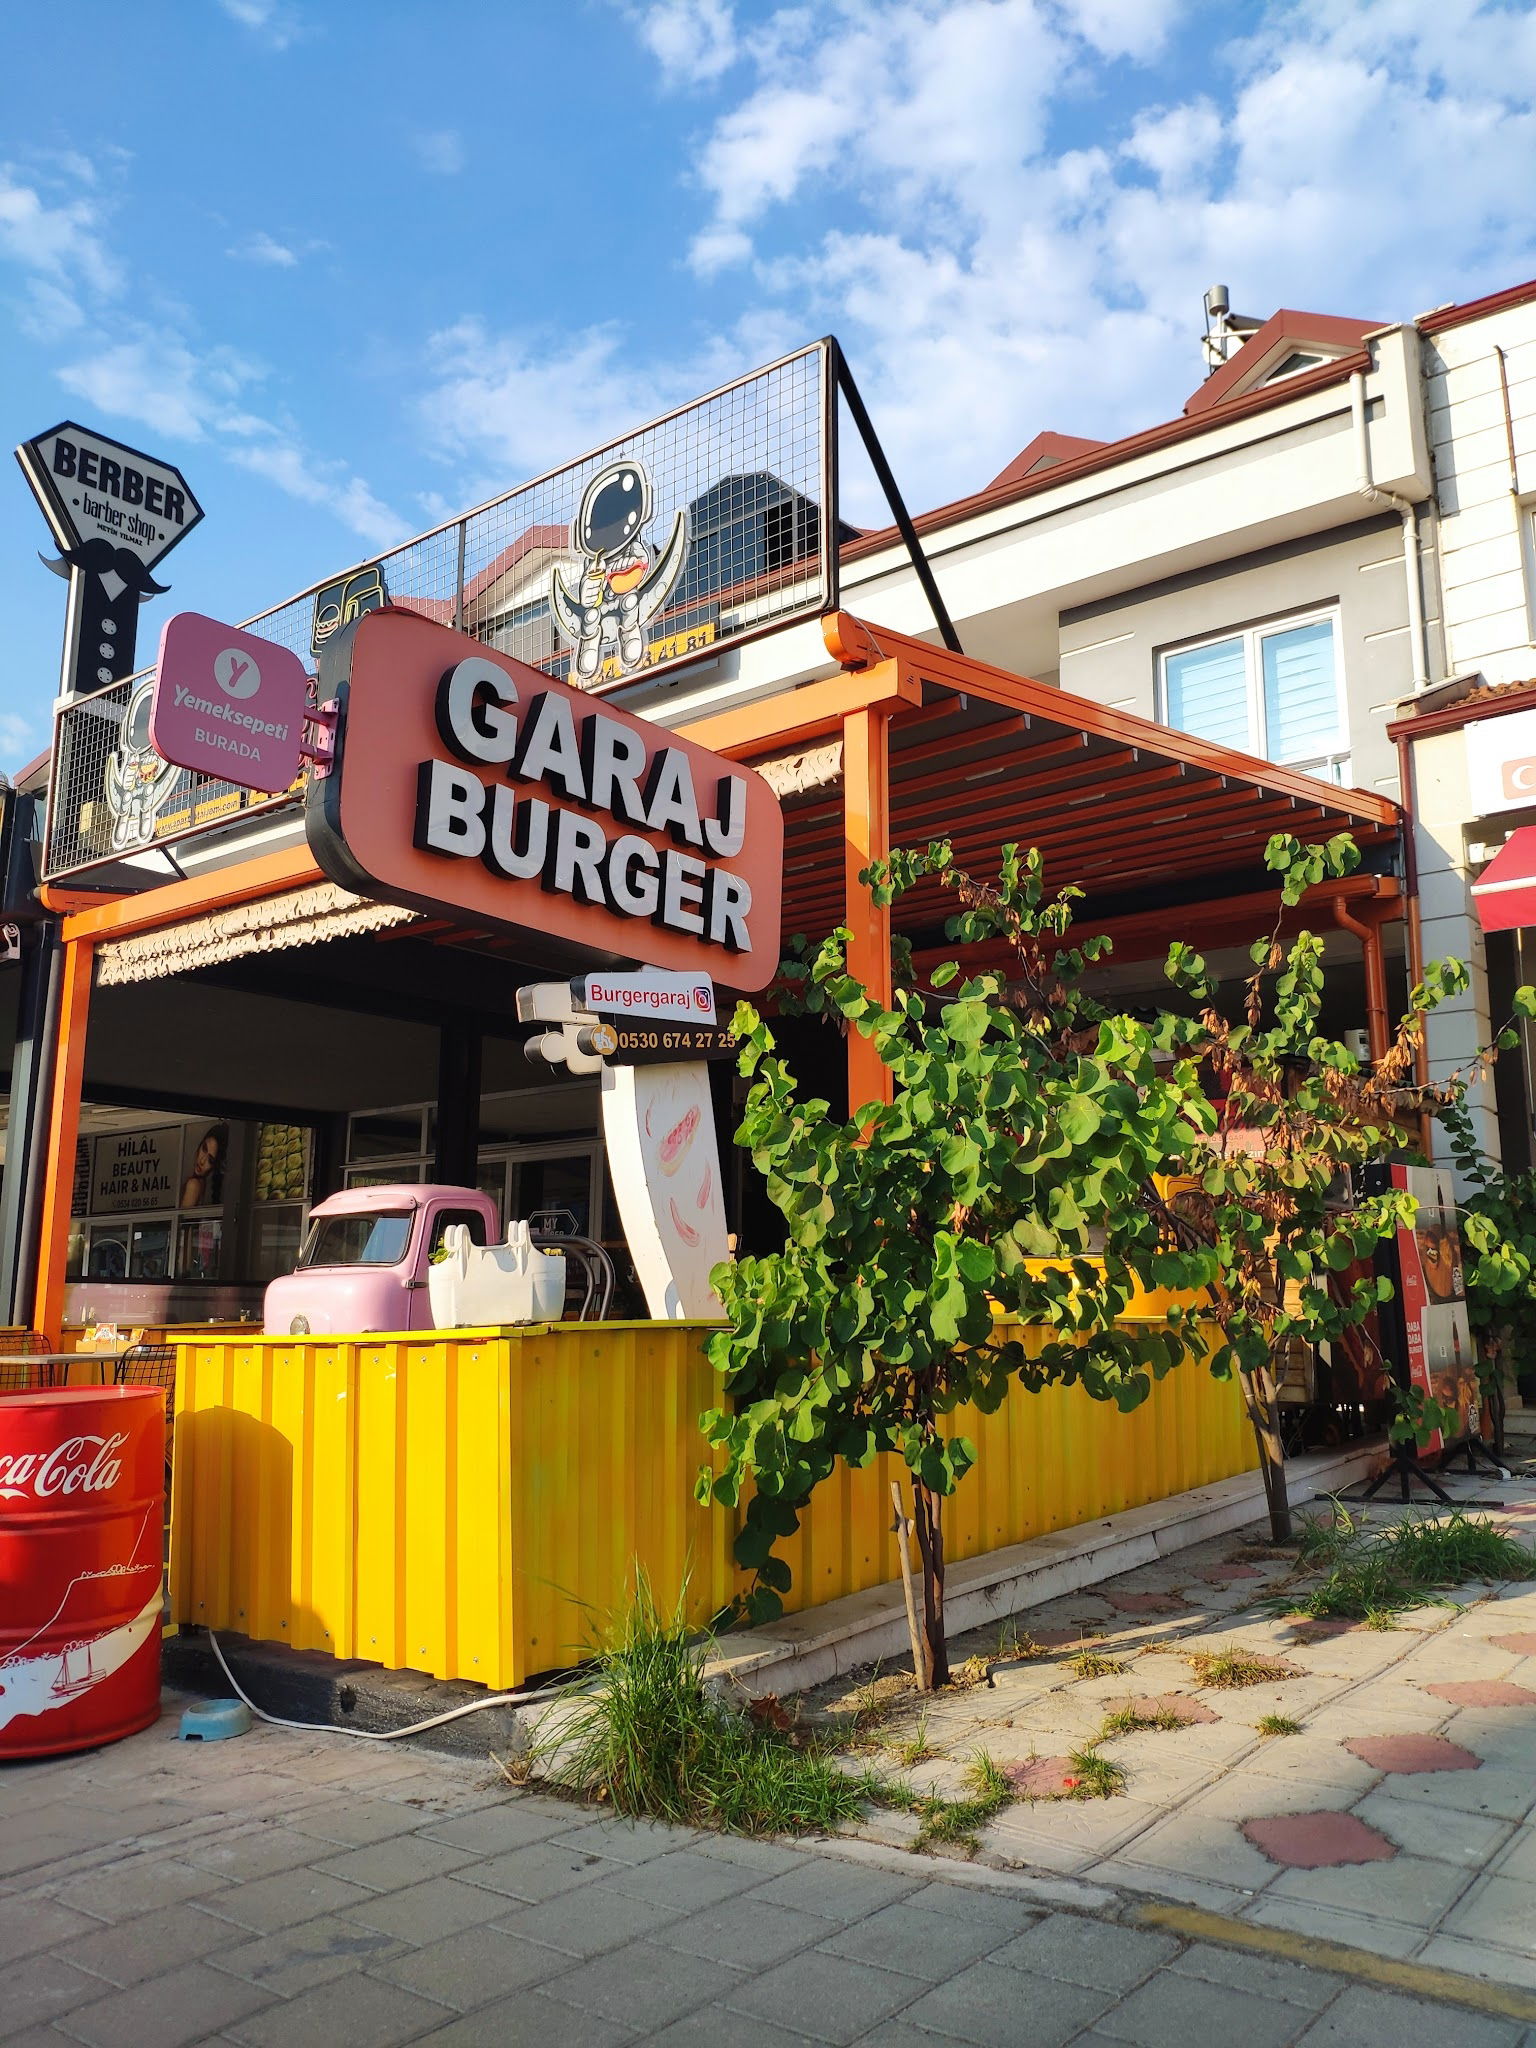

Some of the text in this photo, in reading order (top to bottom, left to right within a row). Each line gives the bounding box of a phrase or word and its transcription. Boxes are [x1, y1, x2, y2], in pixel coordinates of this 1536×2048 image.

[53, 437, 185, 526] BERBER
[83, 492, 156, 545] barber shop
[119, 532, 144, 546] YILMAZ
[173, 684, 289, 742] Yemeksepeti
[194, 728, 262, 763] BURADA
[437, 656, 747, 859] GARAJ
[415, 758, 753, 955] BURGER
[590, 984, 690, 1010] Burgergaraj
[618, 1032, 736, 1049] 0530 674 27 25
[118, 1135, 157, 1157] HİLÂL
[112, 1158, 161, 1178] BEAUTY
[100, 1175, 171, 1196] HAIR & NAIL
[543, 1217, 558, 1229] MY
